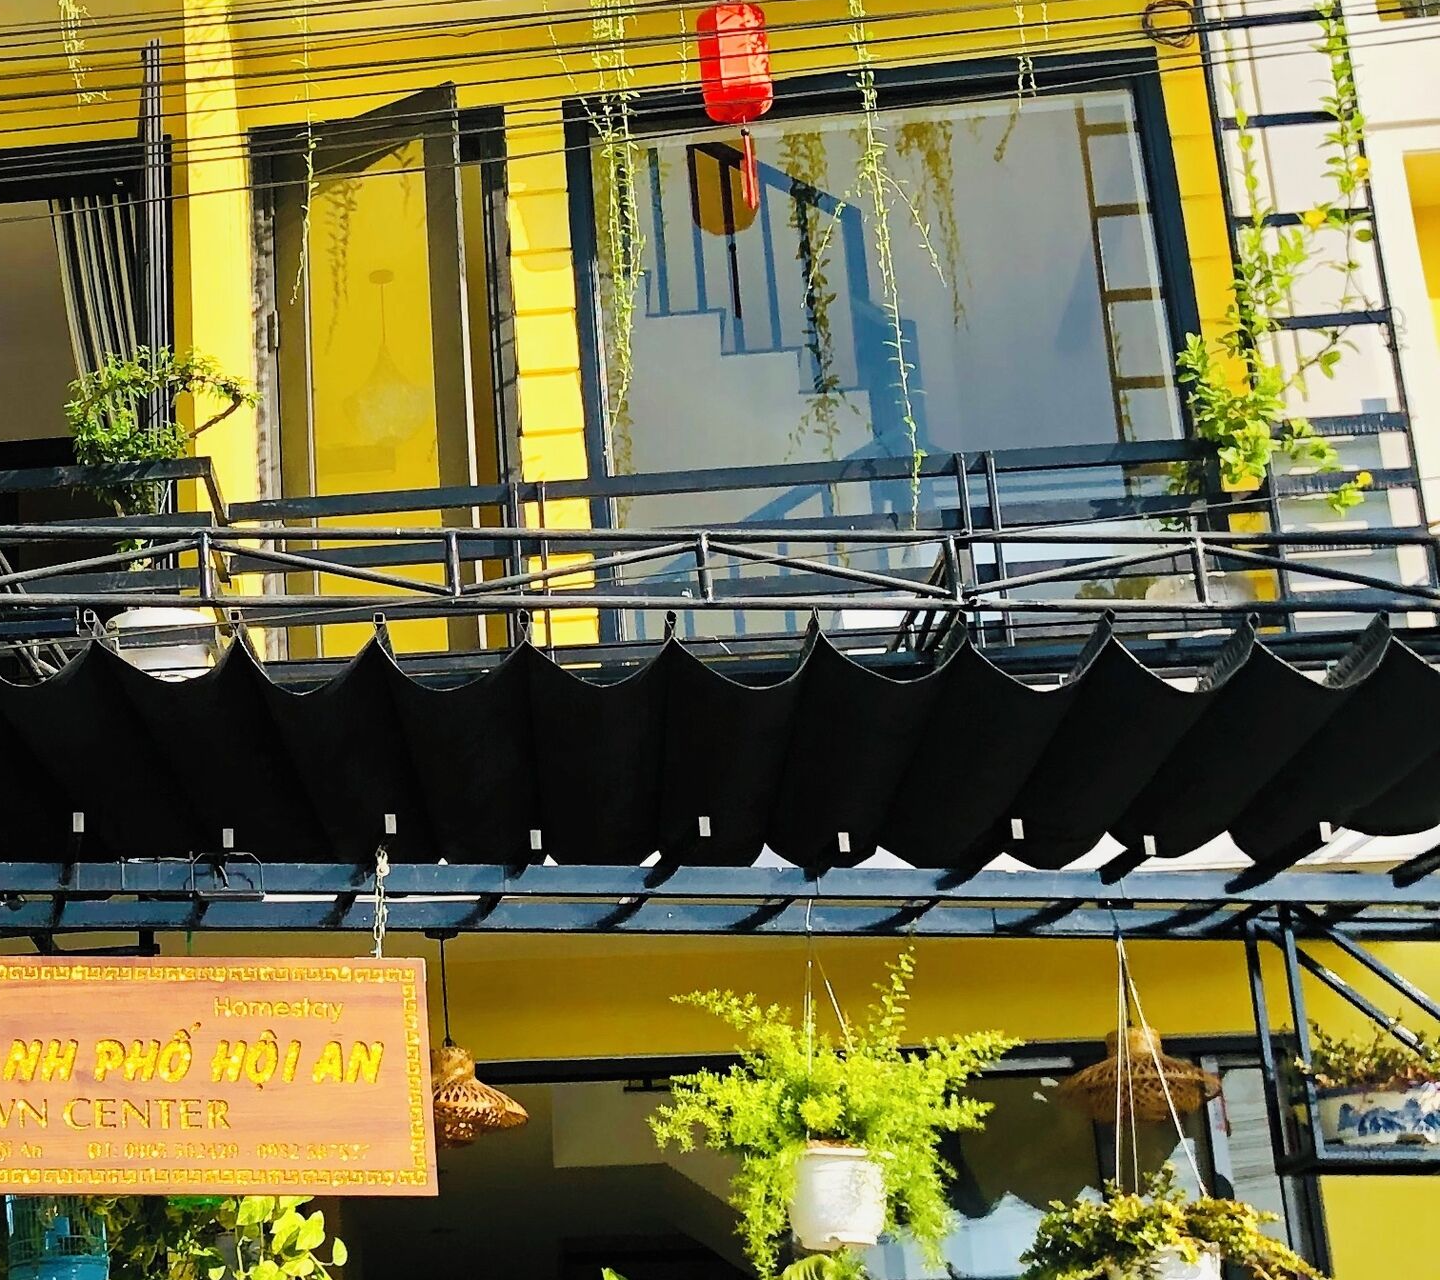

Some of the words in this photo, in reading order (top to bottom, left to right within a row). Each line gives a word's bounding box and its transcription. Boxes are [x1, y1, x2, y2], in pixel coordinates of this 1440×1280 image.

[213, 996, 344, 1024] Homestay
[93, 1022, 202, 1083] PHỐ
[210, 1028, 302, 1091] HỘI
[311, 1040, 384, 1084] AN
[61, 1097, 231, 1130] CENTER
[20, 1141, 43, 1158] An
